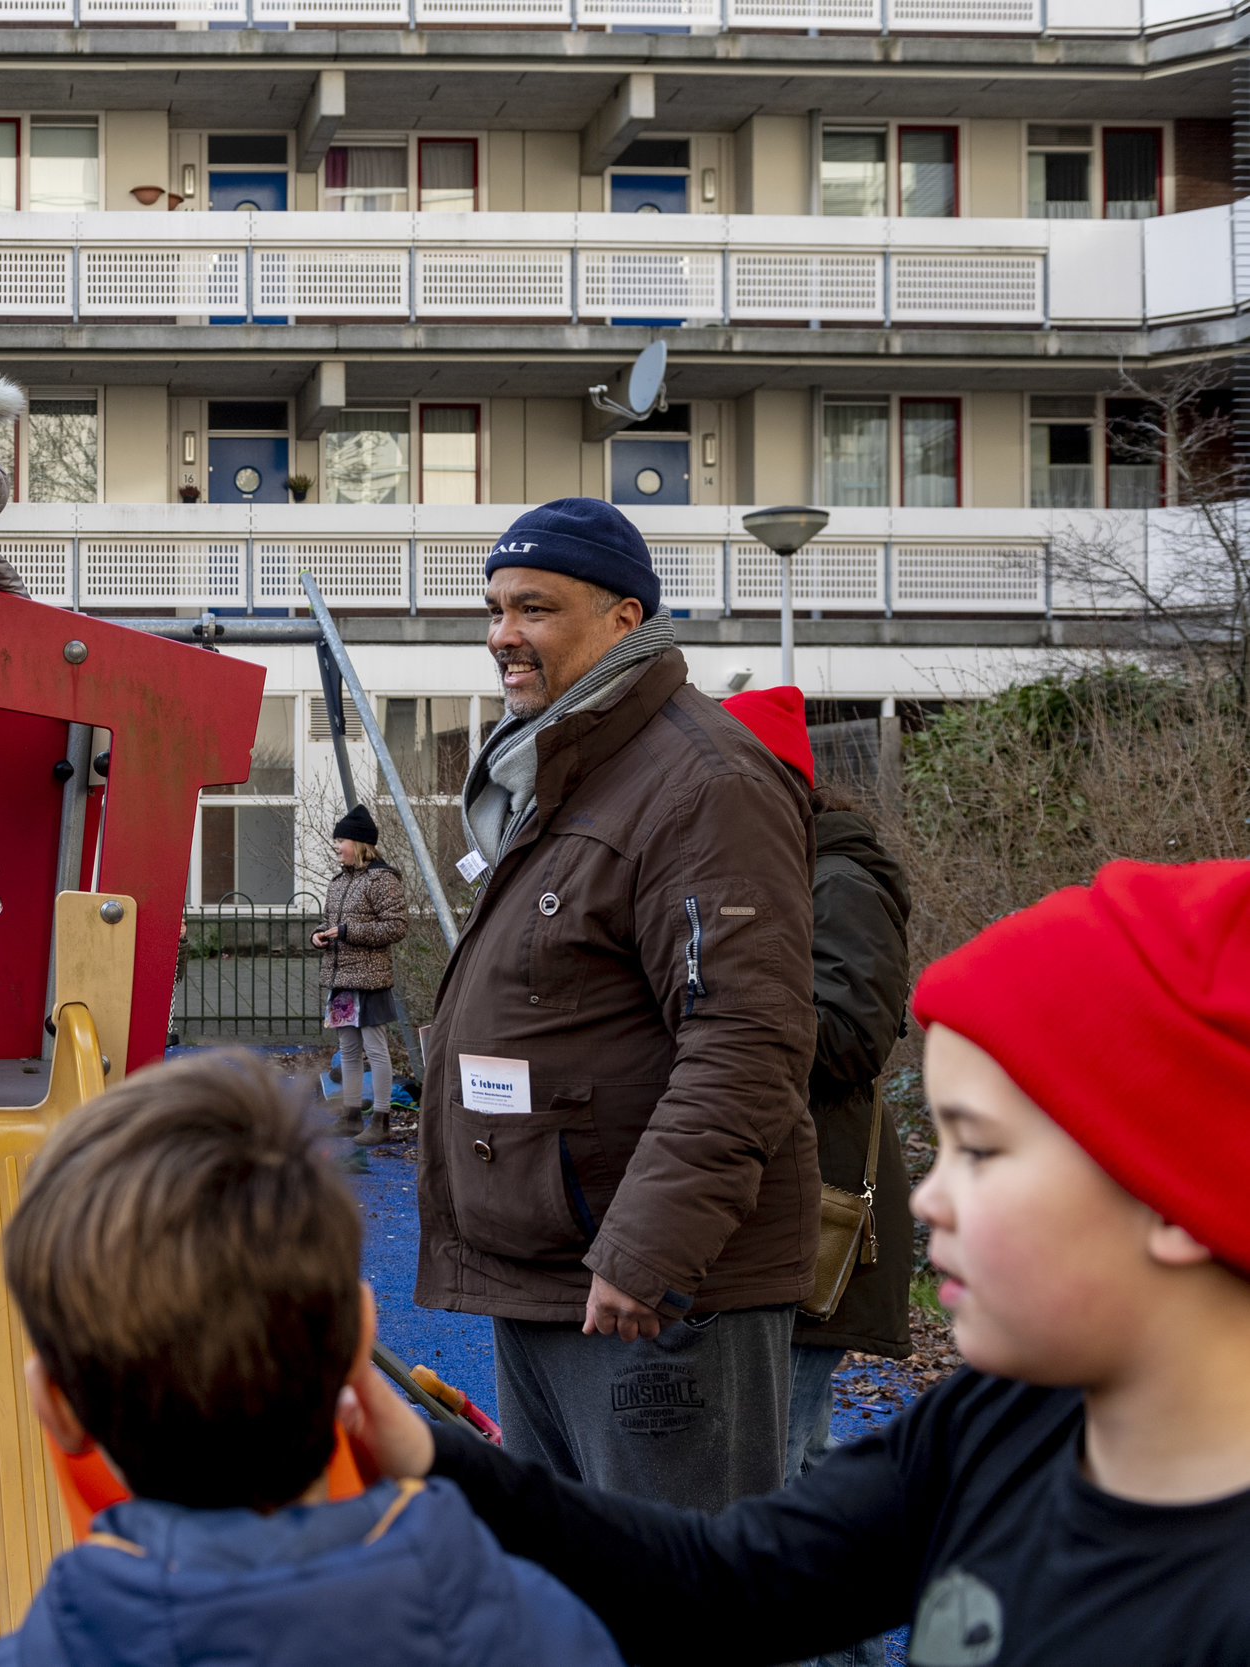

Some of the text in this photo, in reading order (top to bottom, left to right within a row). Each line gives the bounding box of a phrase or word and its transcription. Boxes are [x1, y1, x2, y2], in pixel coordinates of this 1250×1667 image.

[184, 474, 194, 484] 16
[488, 542, 539, 558] ALT
[471, 1079, 513, 1092] 6 februari
[611, 1380, 704, 1411] LONSDALE
[639, 1407, 675, 1418] LONDON
